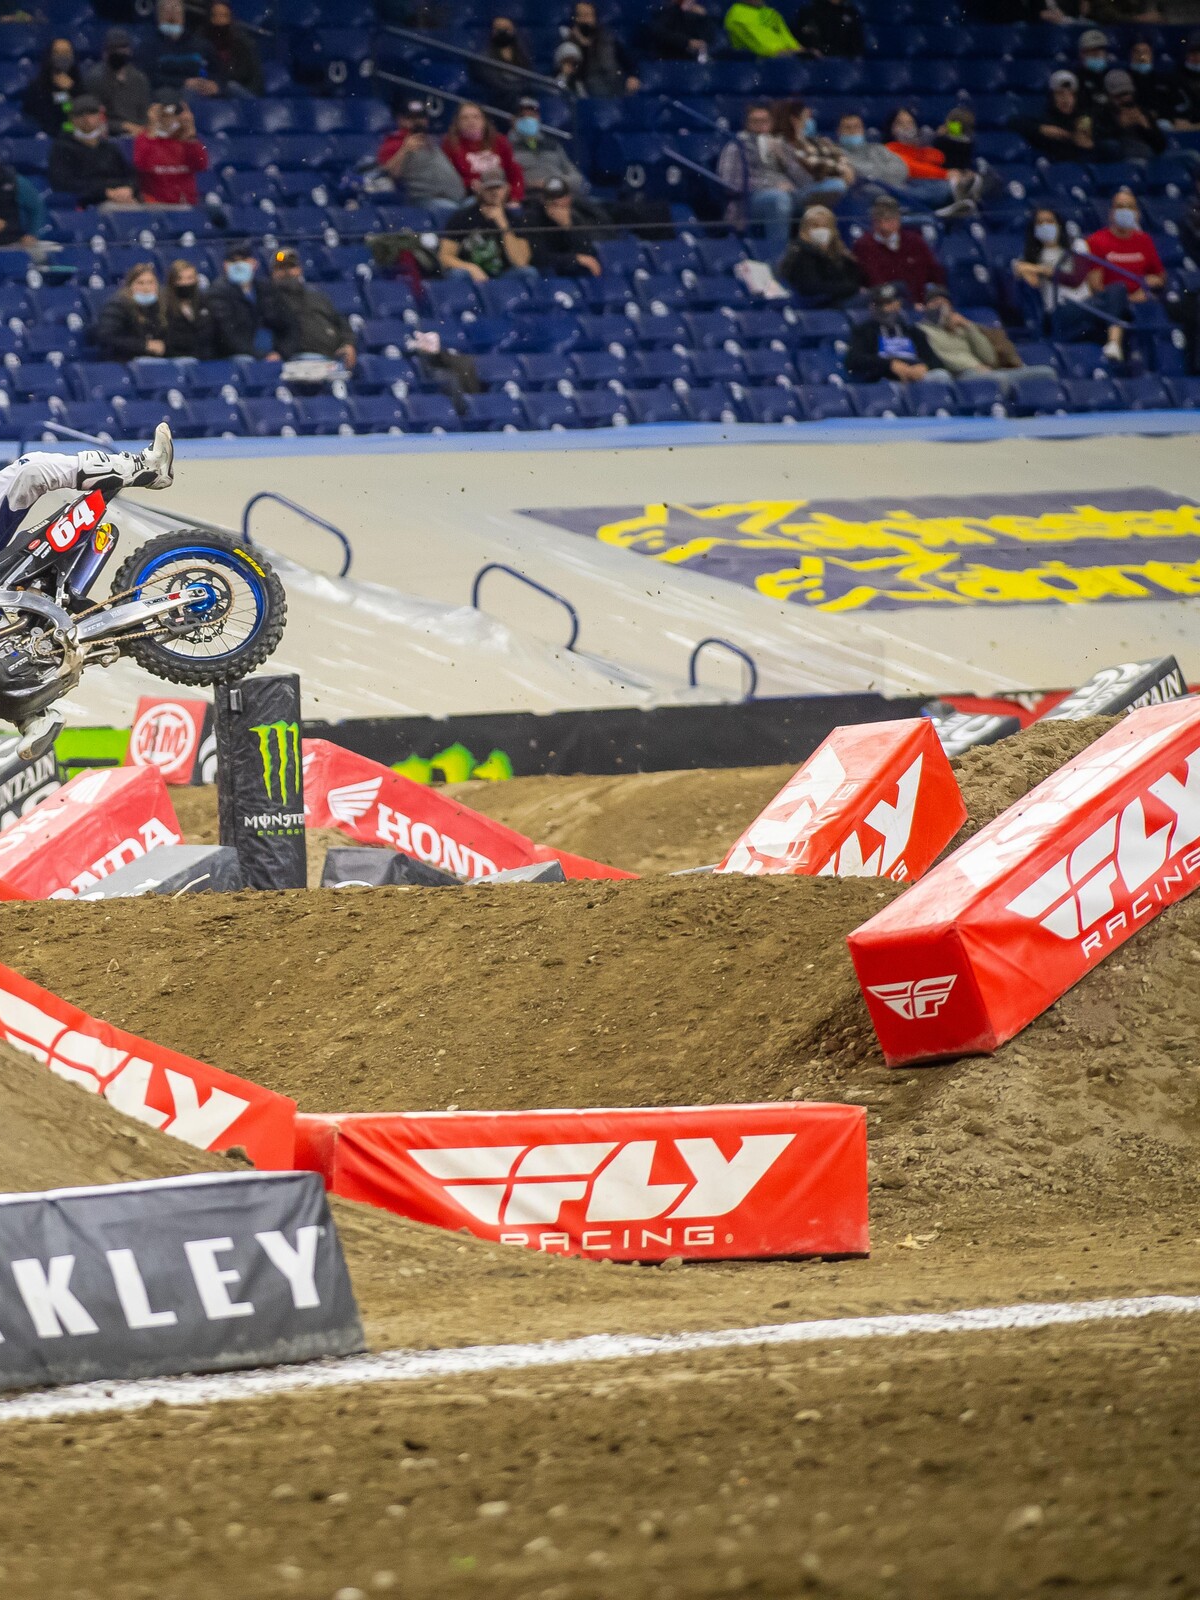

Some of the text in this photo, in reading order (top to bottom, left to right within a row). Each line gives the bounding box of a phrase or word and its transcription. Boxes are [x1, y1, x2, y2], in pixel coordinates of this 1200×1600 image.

[50, 499, 96, 548] 64
[375, 803, 512, 877] HOND
[407, 1133, 798, 1226] FLY
[500, 1225, 716, 1252] RACING
